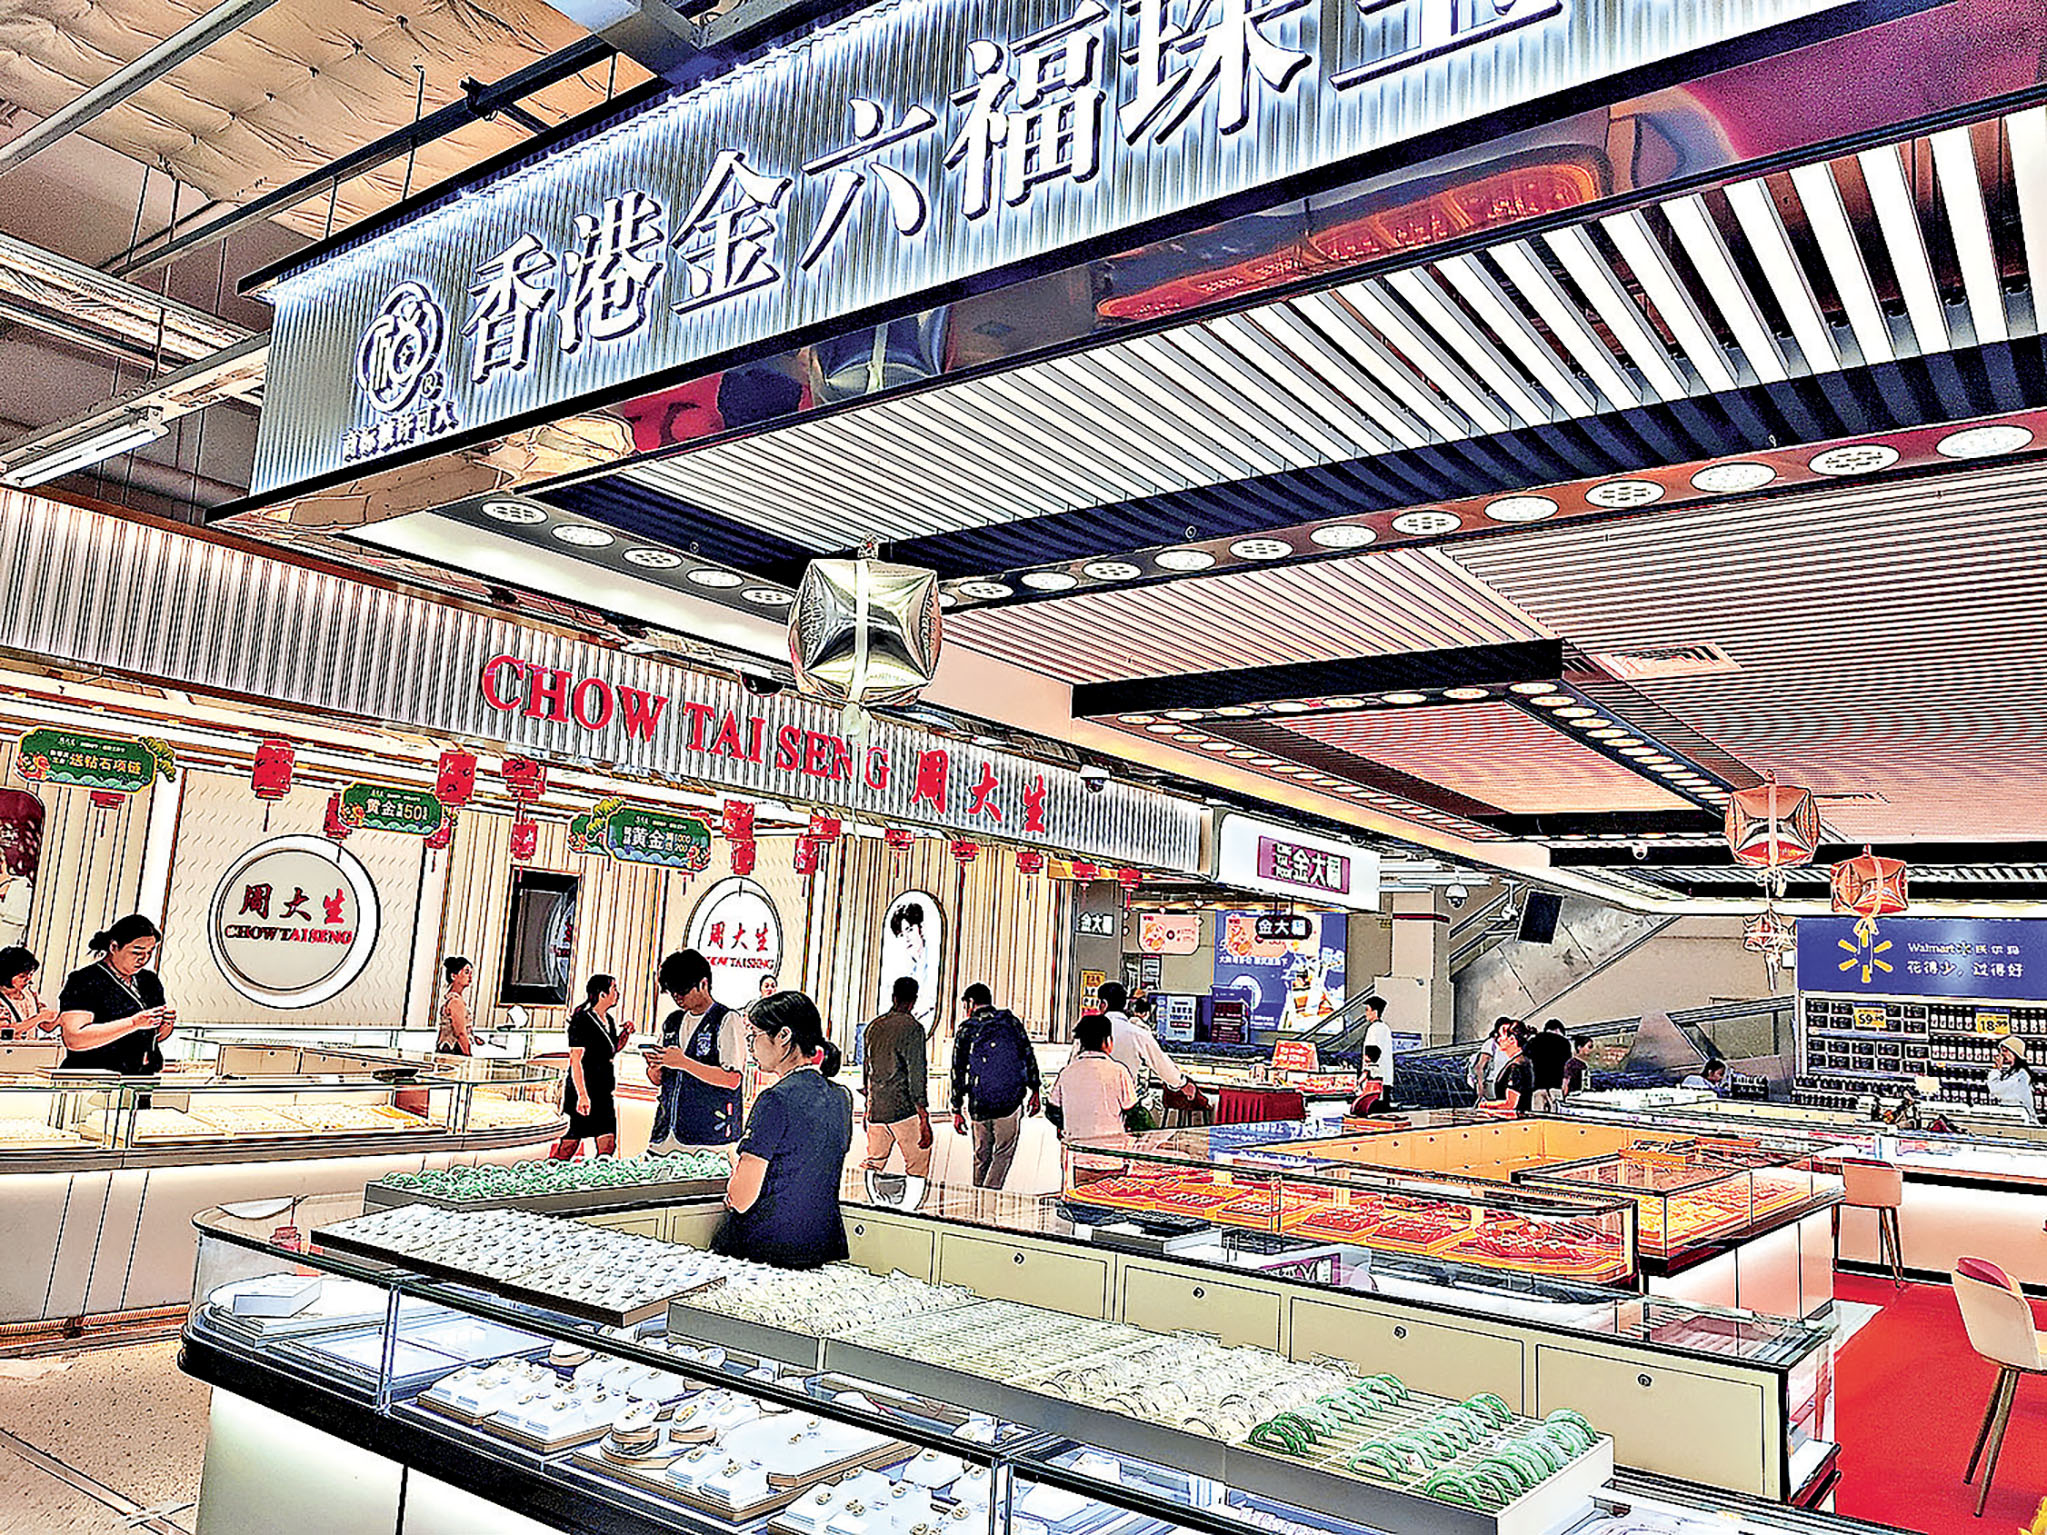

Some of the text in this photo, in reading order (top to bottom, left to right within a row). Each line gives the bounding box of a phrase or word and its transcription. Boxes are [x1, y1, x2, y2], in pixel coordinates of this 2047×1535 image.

[482, 655, 890, 790] CHOW TAI SENG
[912, 749, 1047, 833] 周大生
[238, 883, 346, 925] 周大生
[707, 921, 768, 952] 周大生
[1907, 943, 1955, 953] Walmart
